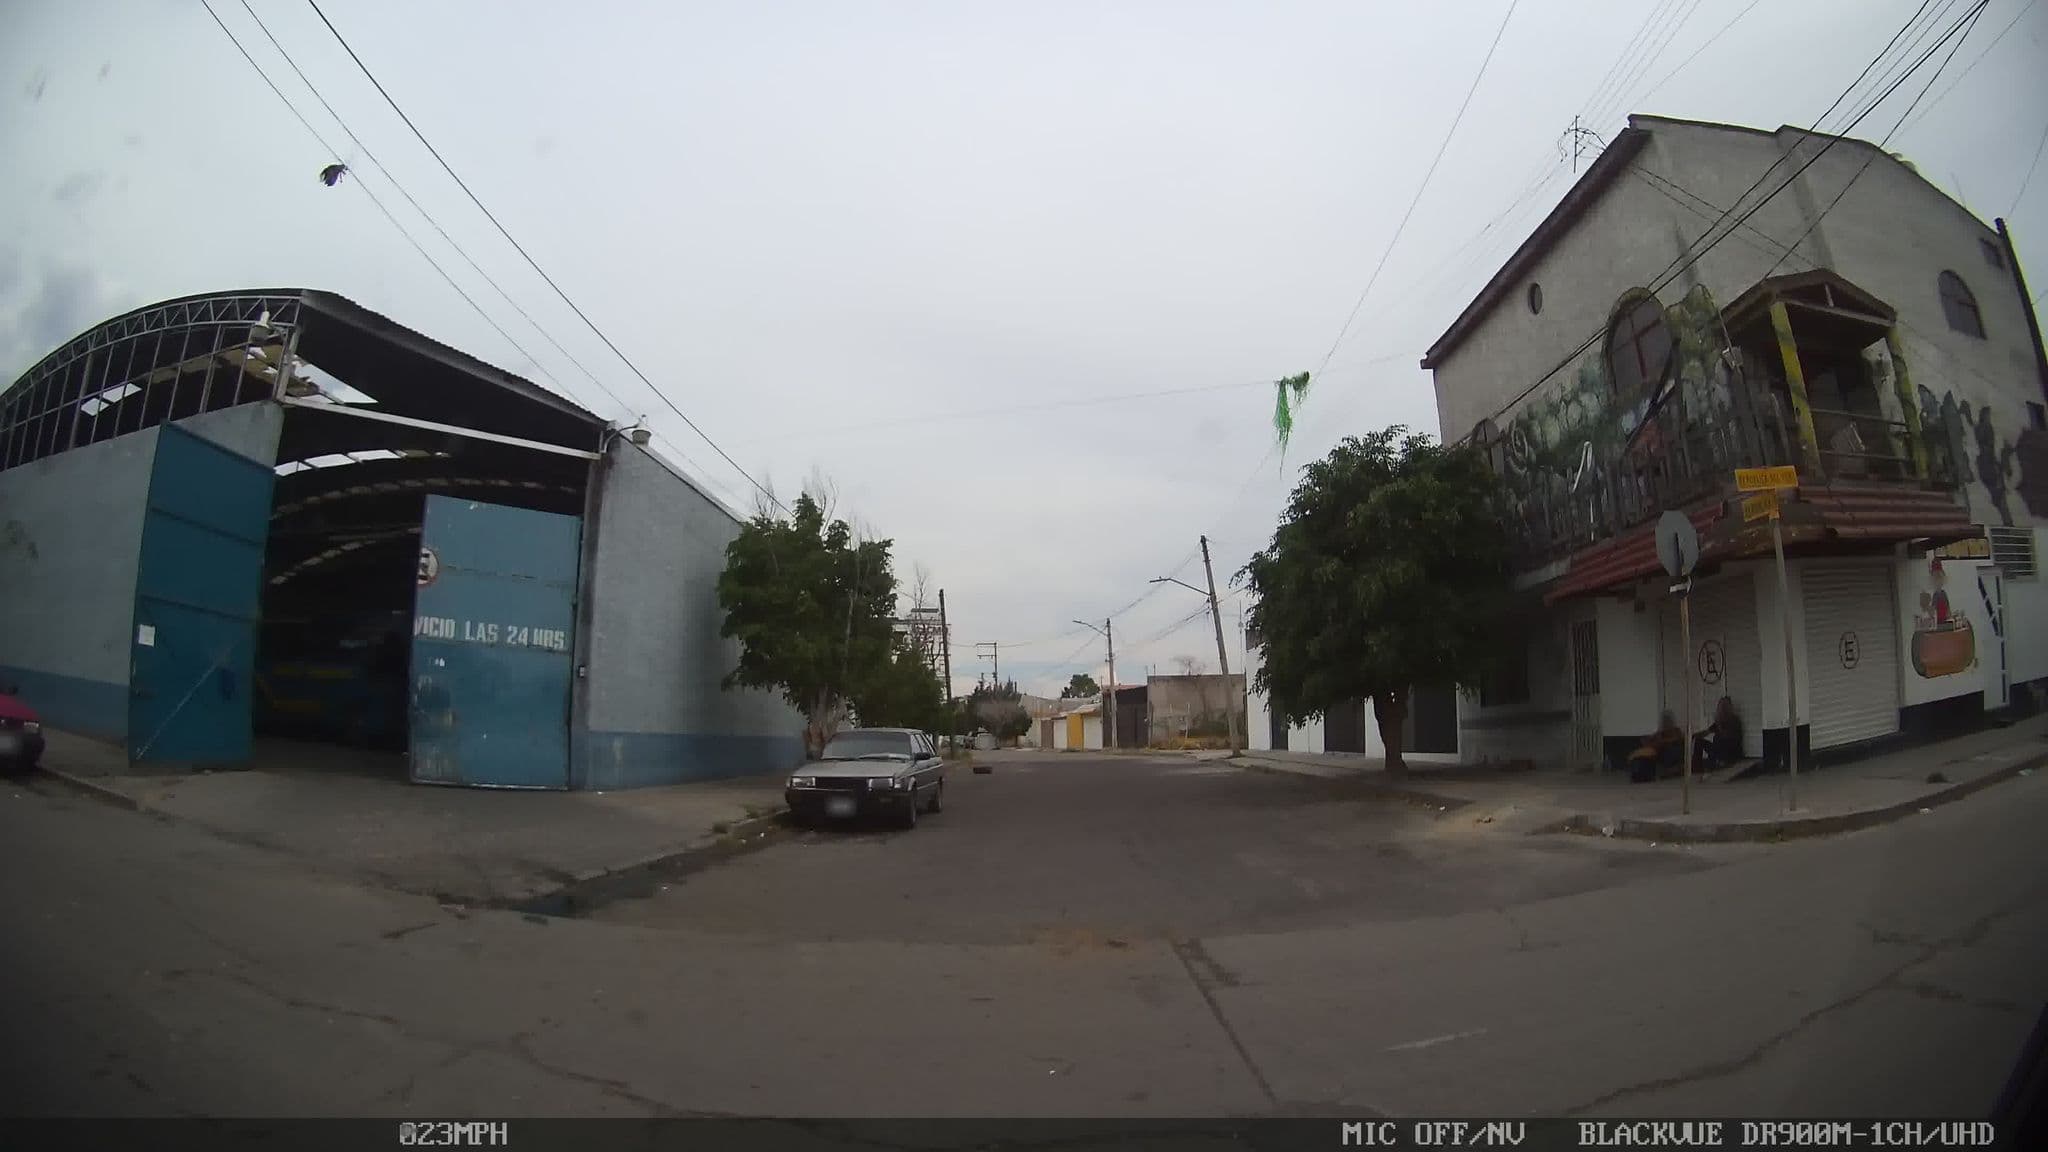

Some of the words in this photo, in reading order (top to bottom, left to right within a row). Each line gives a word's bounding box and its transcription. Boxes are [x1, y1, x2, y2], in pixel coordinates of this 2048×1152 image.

[465, 620, 499, 643] LAS
[506, 625, 529, 647] 24
[533, 628, 565, 650] HRS
